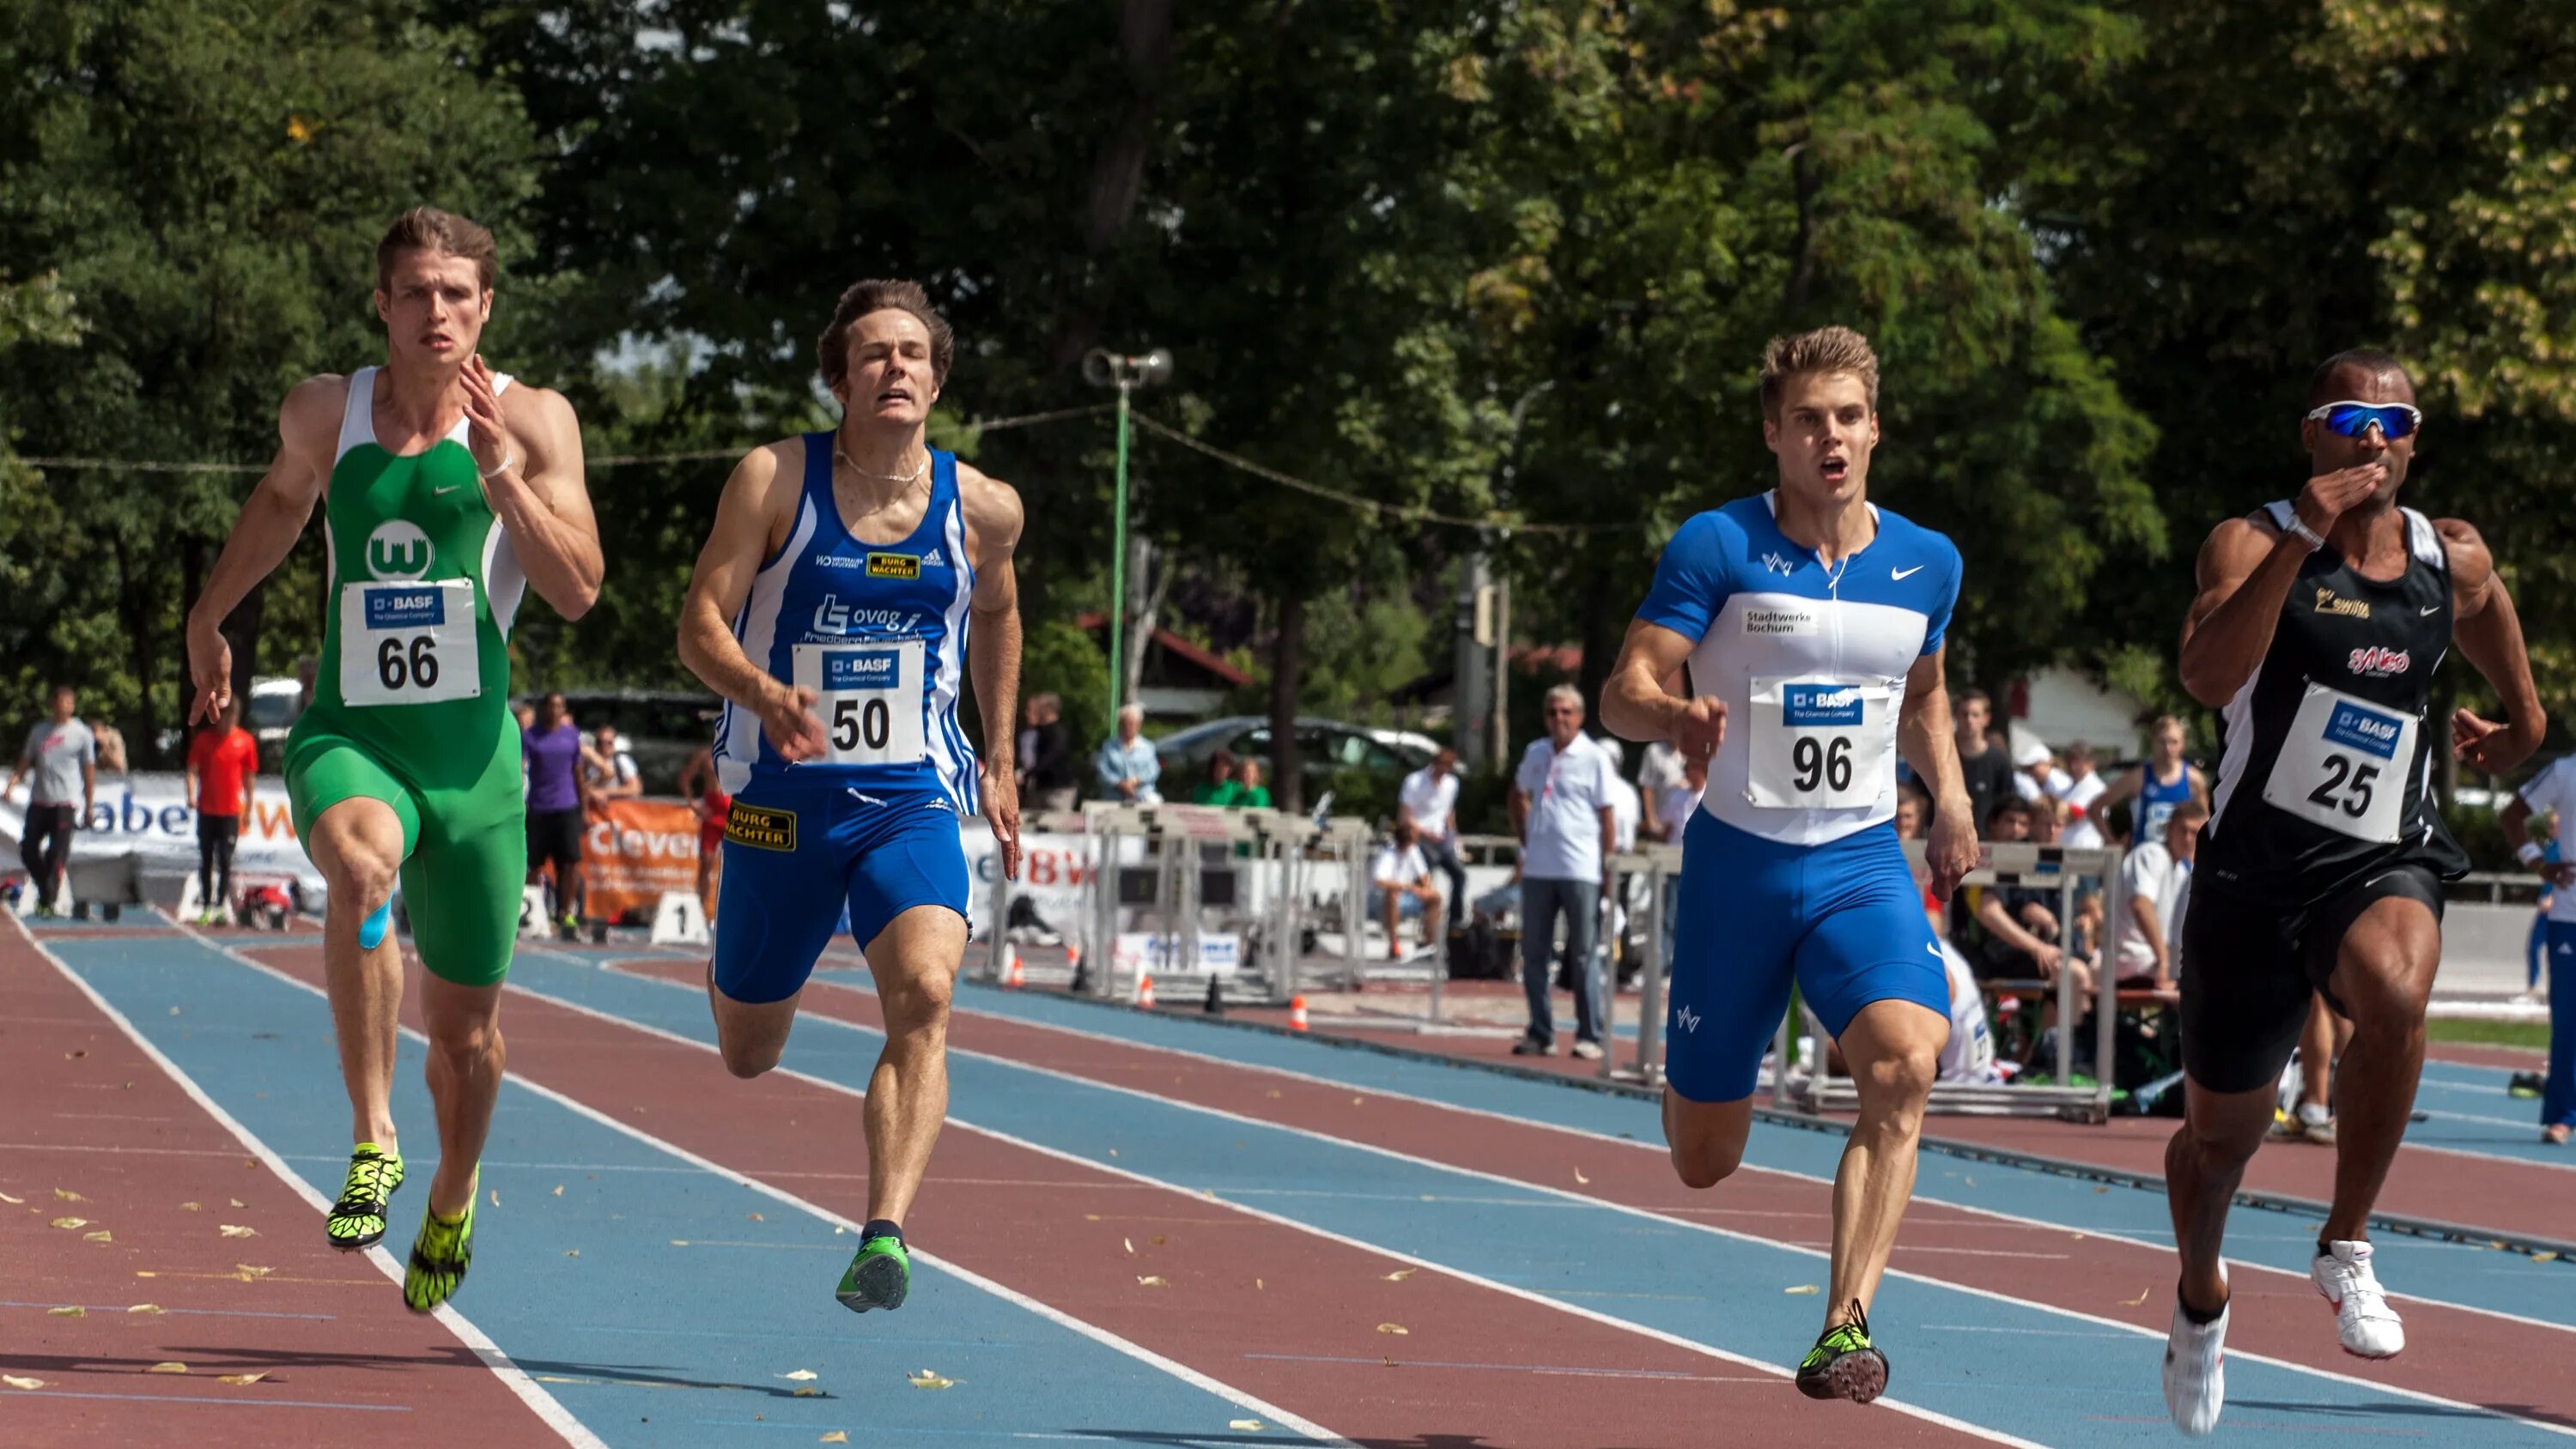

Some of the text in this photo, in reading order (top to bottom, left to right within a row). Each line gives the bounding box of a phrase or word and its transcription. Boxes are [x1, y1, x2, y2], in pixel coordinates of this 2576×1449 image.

[881, 556, 906, 567] BURG
[394, 595, 434, 609] BASF
[854, 609, 901, 631] ovag
[1747, 610, 1811, 622] Stadtwerke
[1747, 622, 1794, 633] Bochum
[378, 635, 439, 690] 66
[853, 658, 892, 673] BASF
[866, 674, 891, 683] Company
[832, 697, 890, 751] 50
[2357, 716, 2397, 741] BASF
[1793, 737, 1852, 792] 96
[2307, 753, 2381, 819] 25
[732, 809, 770, 828] BURG
[675, 905, 689, 935] 1
